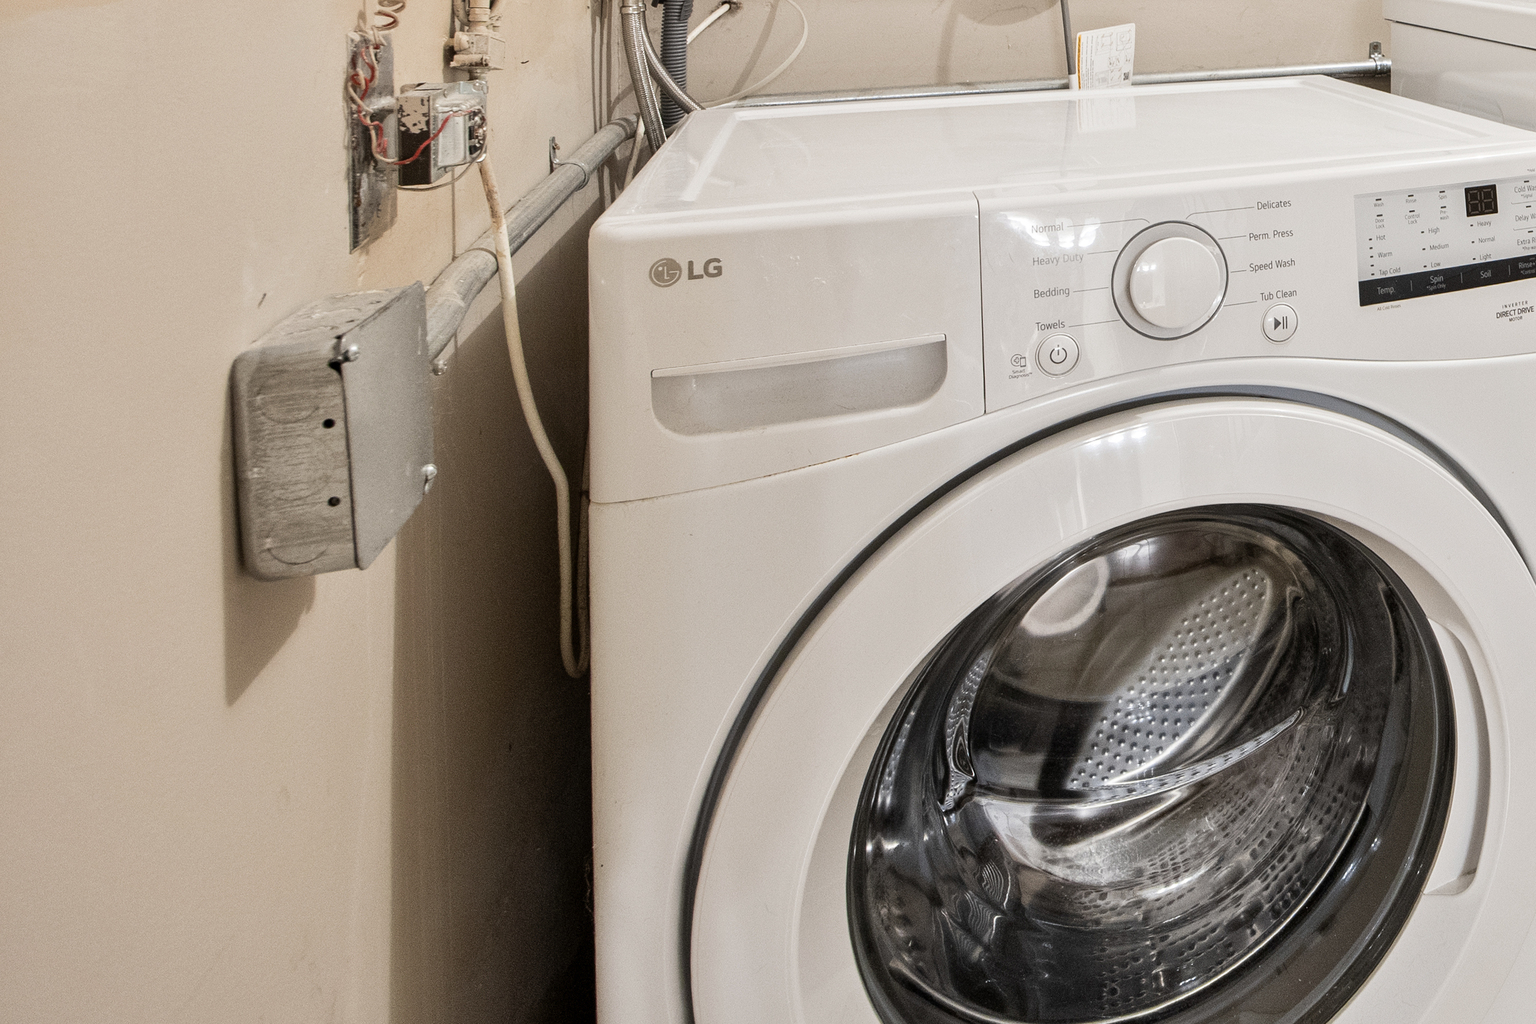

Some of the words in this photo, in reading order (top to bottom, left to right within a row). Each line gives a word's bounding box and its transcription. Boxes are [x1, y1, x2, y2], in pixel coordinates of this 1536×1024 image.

[1256, 199, 1292, 210] Delicates
[1515, 214, 1528, 222] Delay
[1031, 223, 1064, 234] Normal
[1477, 220, 1492, 228] Heavy
[1249, 231, 1270, 242] Perm.
[1273, 229, 1294, 239] Press
[1478, 236, 1495, 244] Normal
[1429, 243, 1449, 251] Medium
[1517, 238, 1530, 246] Extra
[1032, 254, 1060, 266] Heavy
[1062, 253, 1084, 265] Duty
[1480, 253, 1492, 261] Light
[688, 258, 723, 280] LG
[1249, 261, 1274, 273] Speed
[1276, 258, 1296, 269] Wash
[1379, 269, 1388, 277] Tap
[1480, 270, 1492, 279] Soil
[1430, 275, 1444, 285] Spin
[1033, 286, 1070, 299] Bedding
[1259, 291, 1274, 301] Tub
[1276, 289, 1298, 299] Clean
[1377, 286, 1396, 295] Temp.
[1502, 300, 1528, 309] INVERTER
[1496, 309, 1517, 319] DIRECT
[1517, 306, 1535, 316] DRIVE
[1036, 320, 1065, 331] Towels
